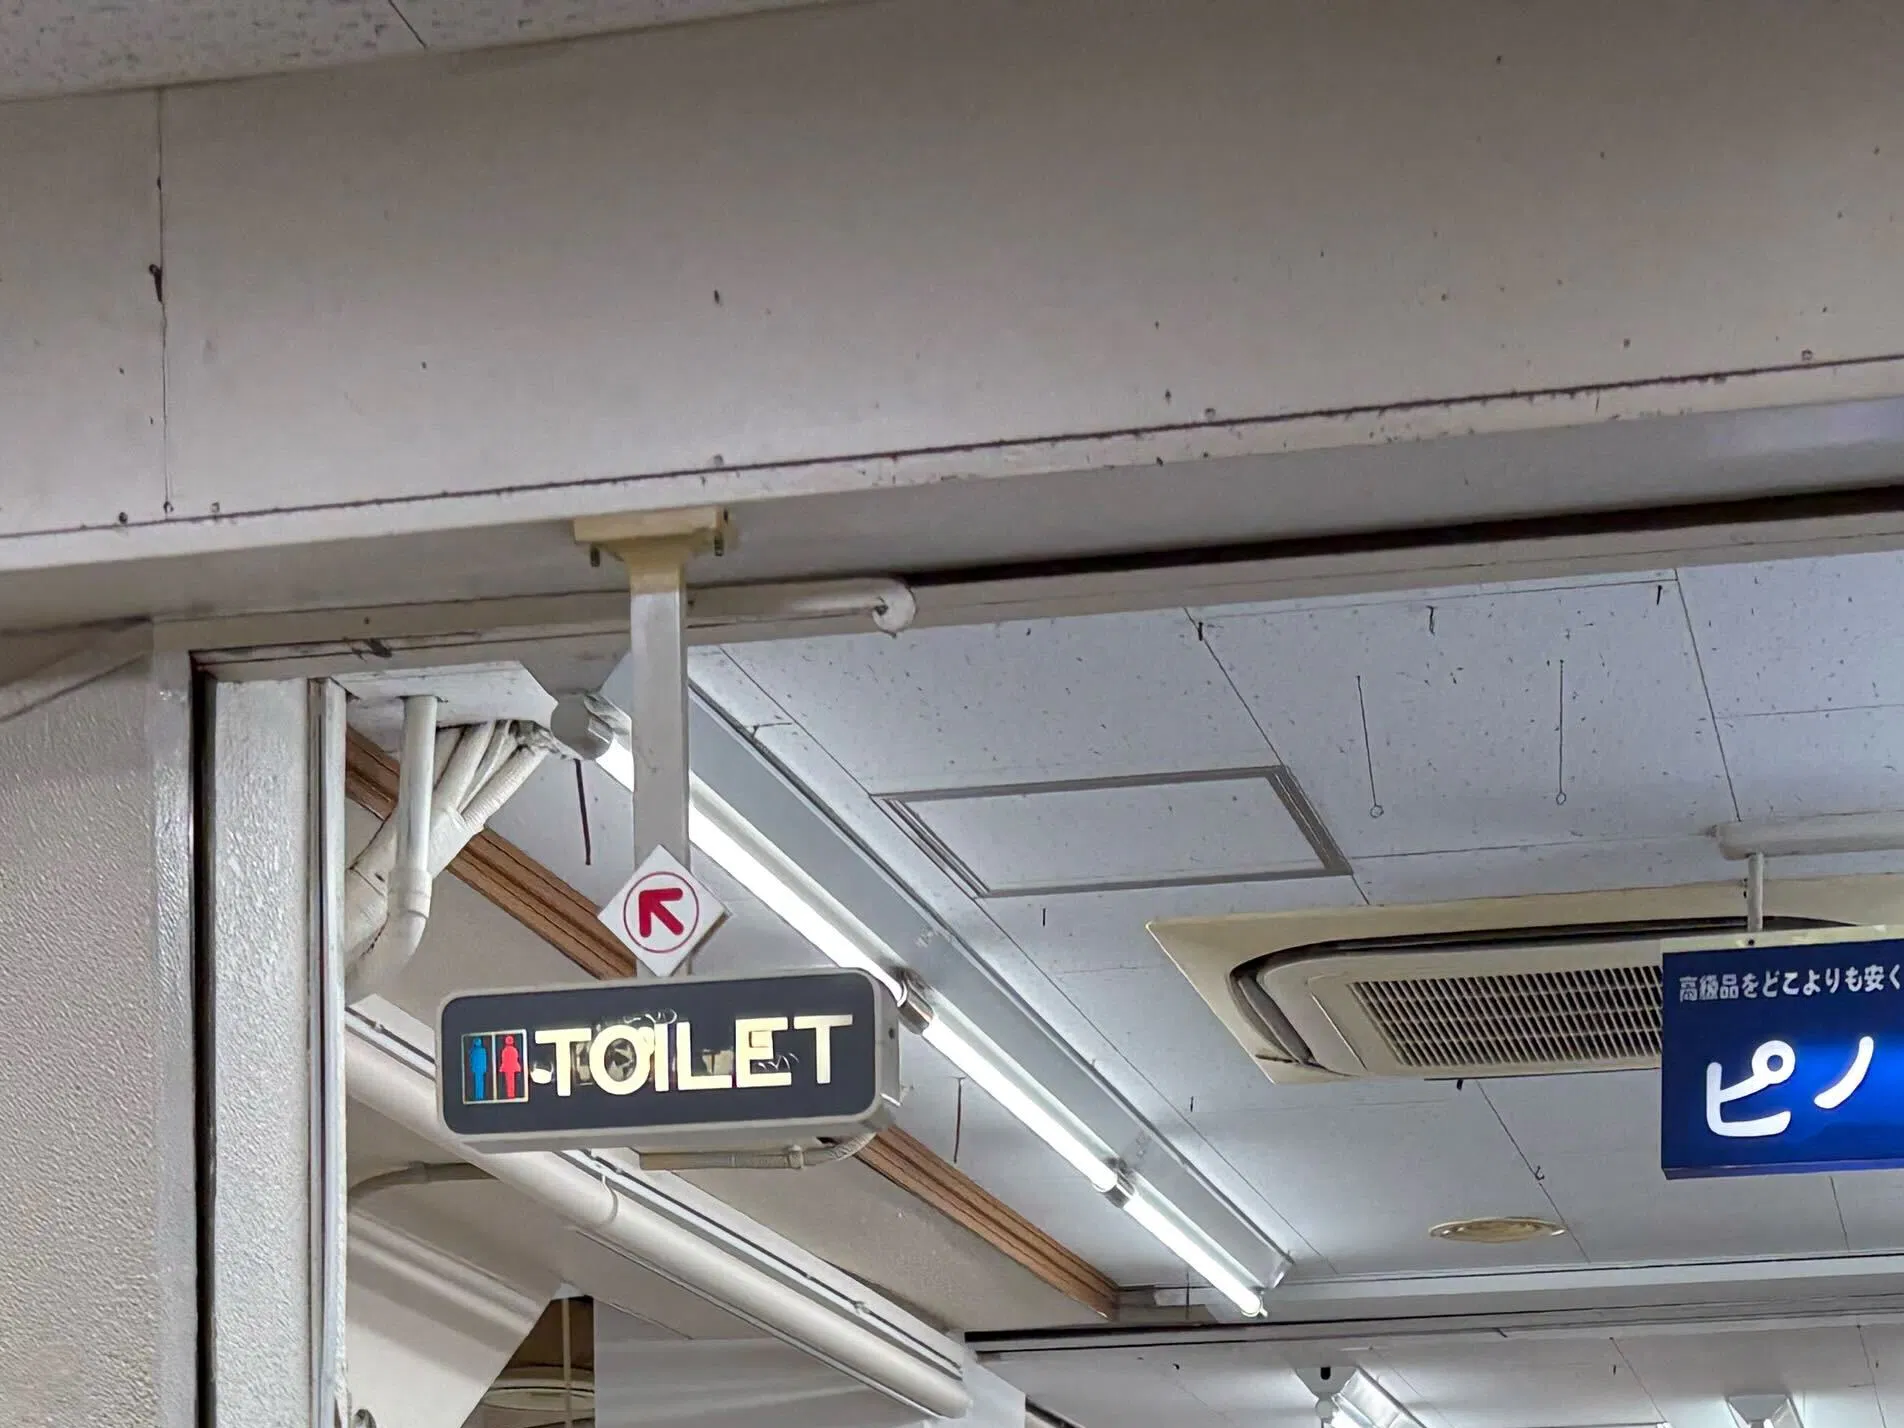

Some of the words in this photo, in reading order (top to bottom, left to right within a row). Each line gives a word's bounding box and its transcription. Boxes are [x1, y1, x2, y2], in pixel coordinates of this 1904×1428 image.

[1679, 963, 1902, 1003] 高級品をどこよりも安く
[533, 1014, 854, 1097] TOILET
